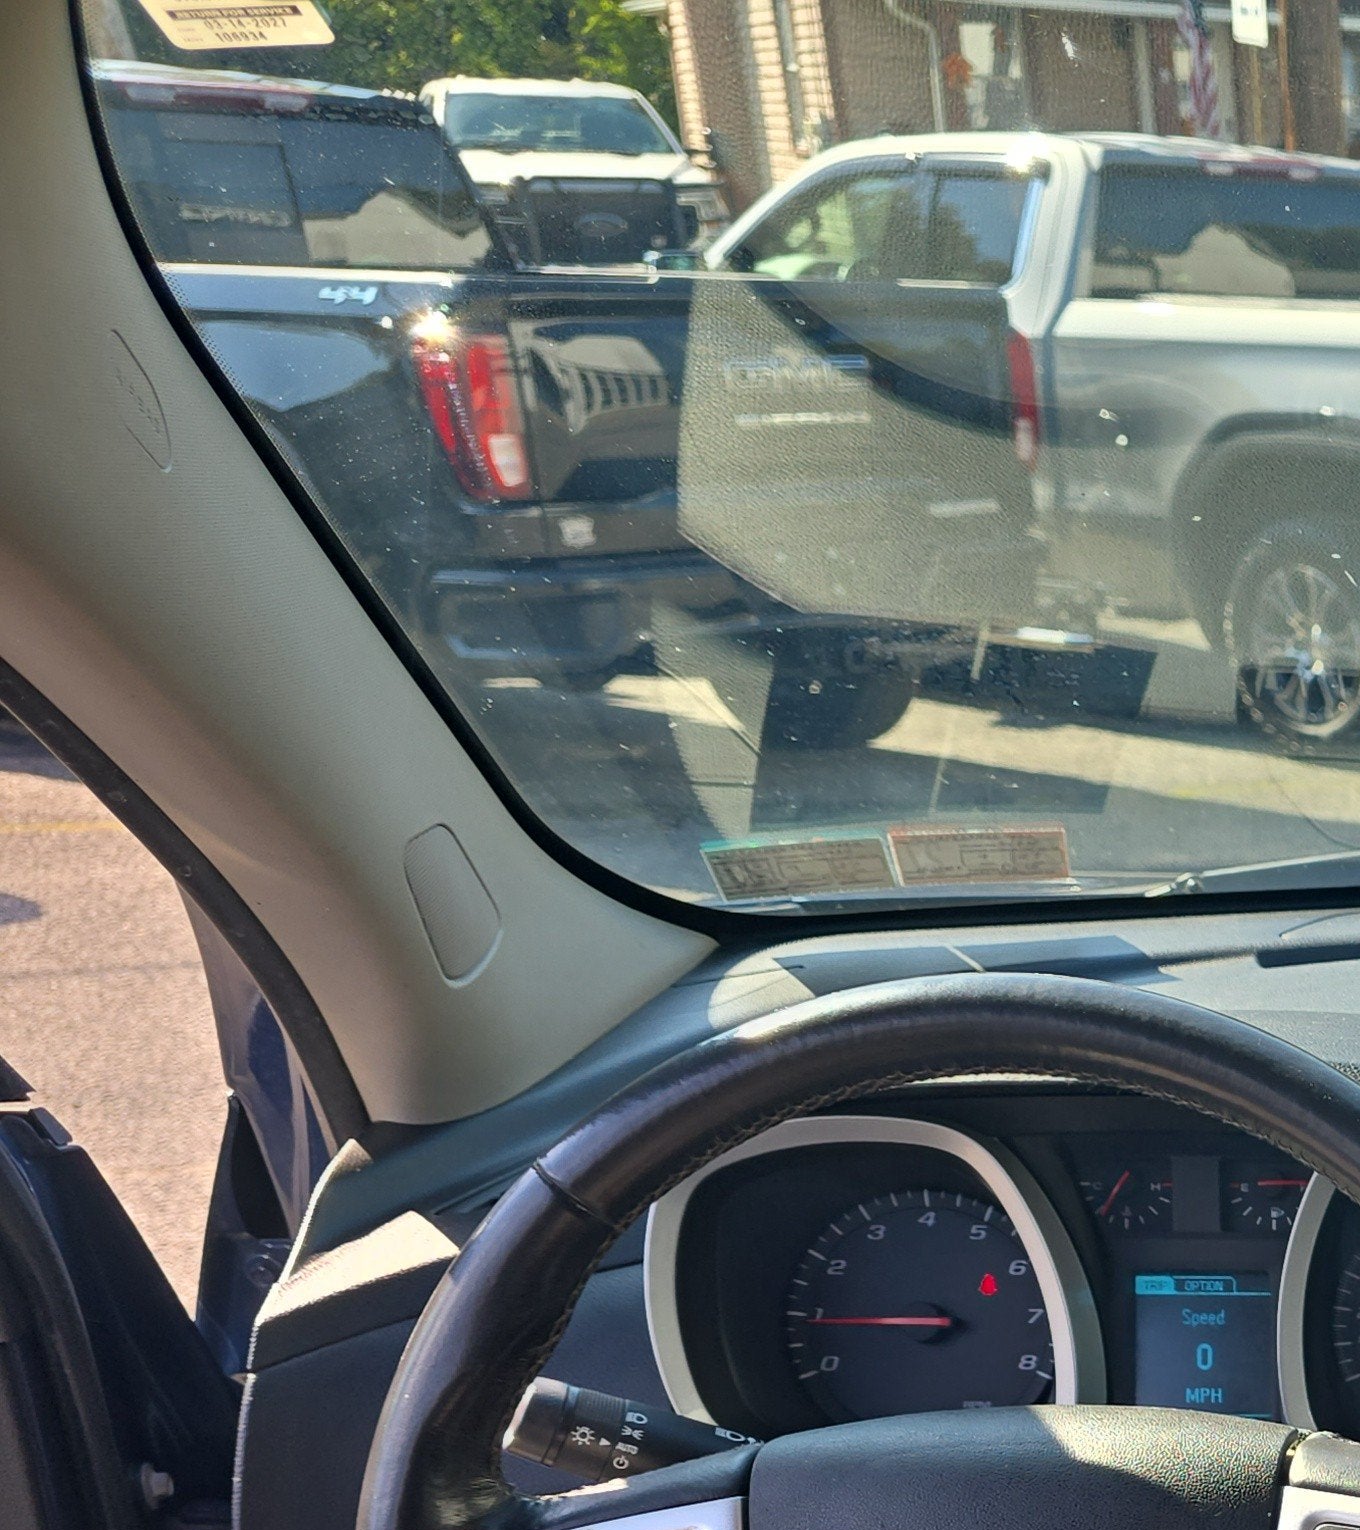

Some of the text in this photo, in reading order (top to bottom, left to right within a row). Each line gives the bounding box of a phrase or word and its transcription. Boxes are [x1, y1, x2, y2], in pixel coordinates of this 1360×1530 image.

[204, 17, 288, 30] 03-14-2027
[918, 1211, 937, 1227] 4
[867, 1224, 886, 1240] 3
[969, 1224, 988, 1240] 5
[827, 1259, 847, 1275] 2
[1008, 1259, 1028, 1275] 6
[1184, 1280, 1223, 1292] OPTION
[1026, 1308, 1045, 1324] 7
[1182, 1308, 1226, 1327] Speed
[820, 1355, 839, 1371] 0
[1018, 1354, 1037, 1370] 8
[1196, 1343, 1214, 1371] 0
[1185, 1388, 1223, 1403] MPH
